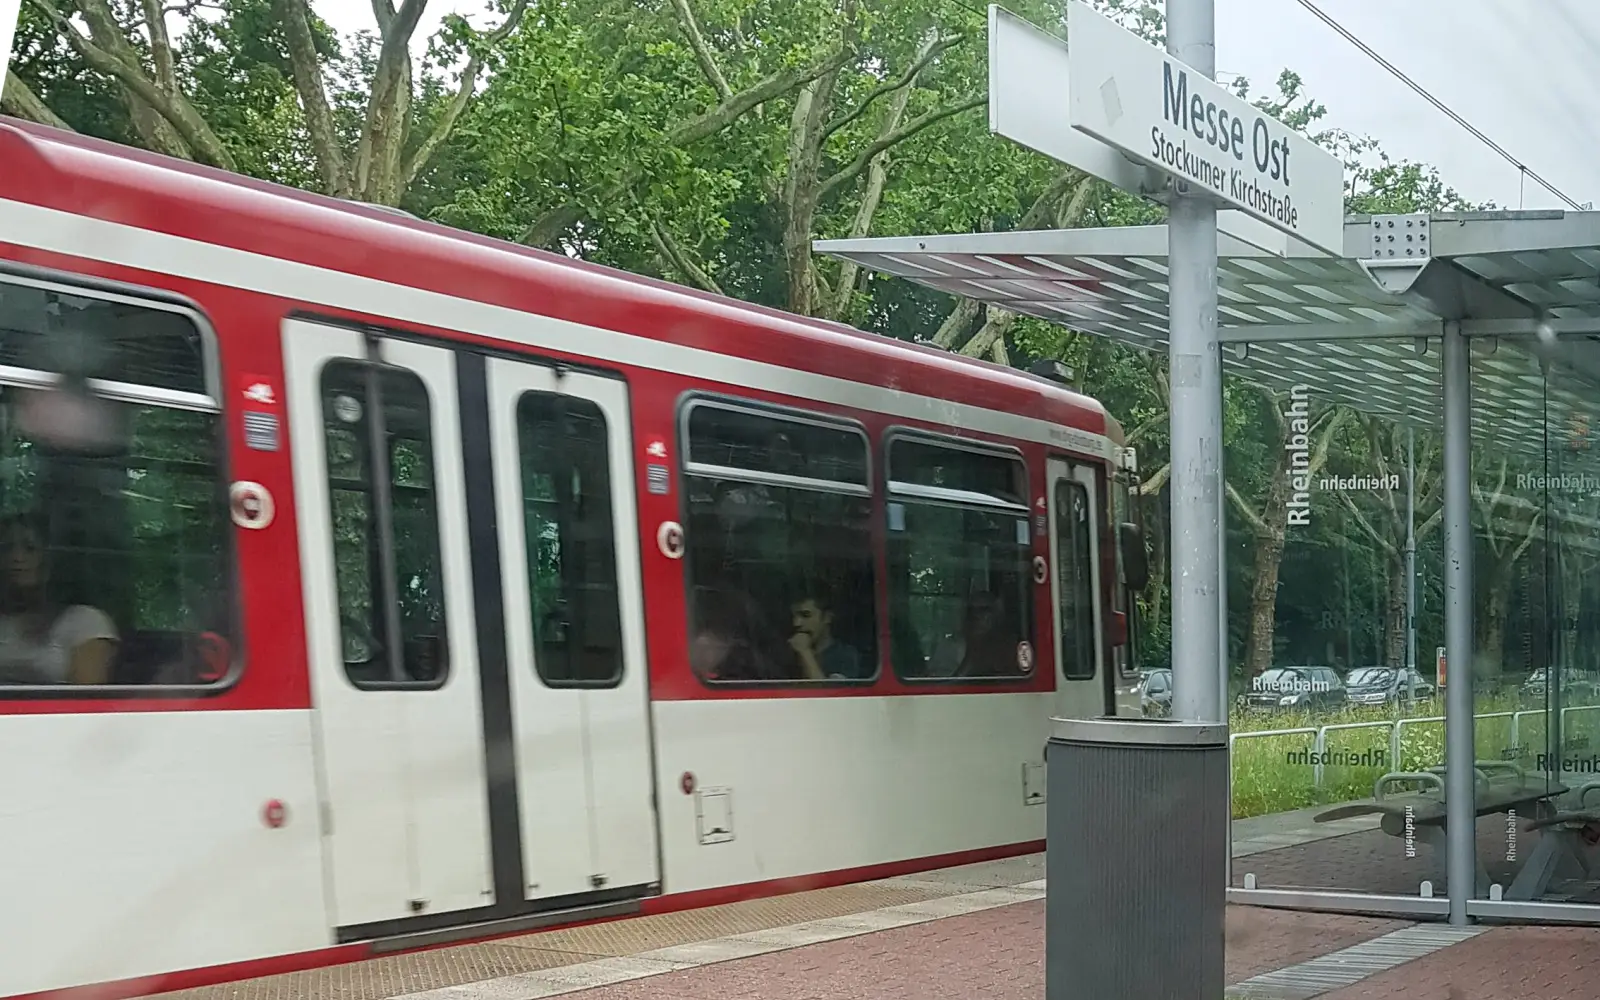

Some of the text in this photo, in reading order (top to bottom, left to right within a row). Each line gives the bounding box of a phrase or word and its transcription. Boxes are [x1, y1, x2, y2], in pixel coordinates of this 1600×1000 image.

[1163, 60, 1290, 187] Messe Ost
[1151, 126, 1298, 229] Stockumer Kirchstraße
[1284, 383, 1310, 526] Rheinbahn
[1252, 676, 1330, 692] Rheinbahn
[1506, 808, 1517, 861] Rheinbahn
